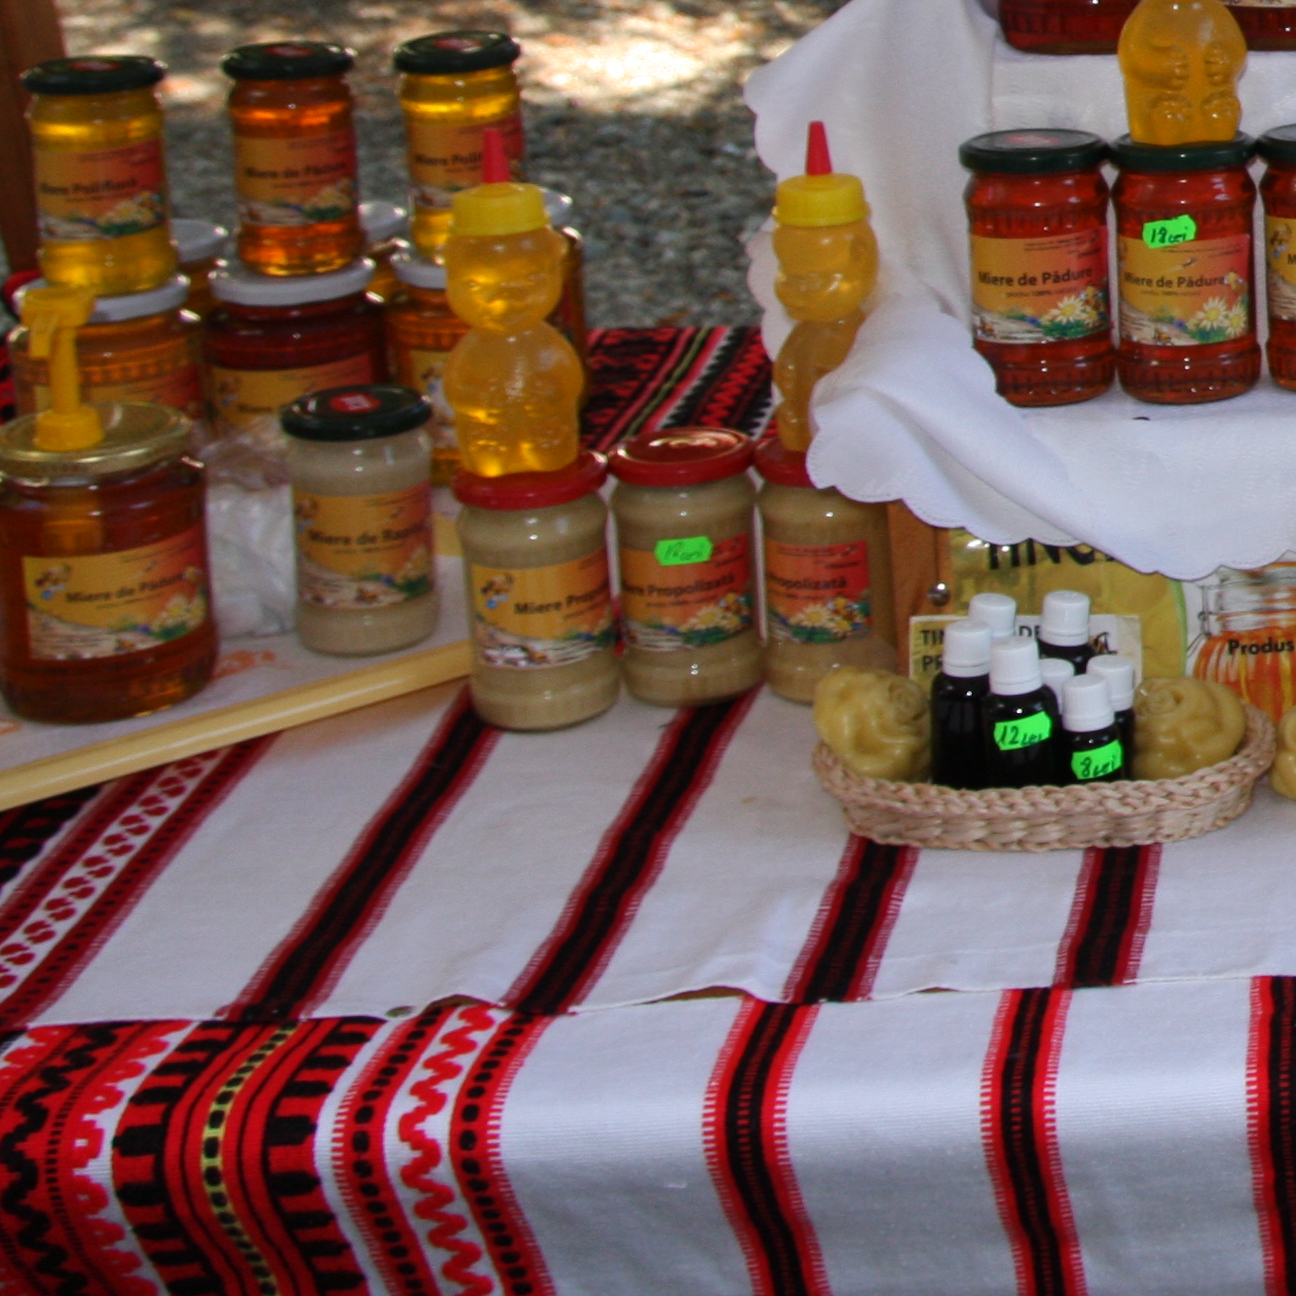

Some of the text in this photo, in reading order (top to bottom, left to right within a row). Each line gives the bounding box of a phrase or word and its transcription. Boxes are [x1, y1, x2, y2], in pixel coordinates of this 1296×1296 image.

[979, 267, 1093, 287] Miere de Pădure
[1124, 272, 1224, 288] Miere de Pădure
[1228, 637, 1294, 655] Produs
[1001, 726, 1018, 746] 12
[1080, 757, 1092, 778] 8
